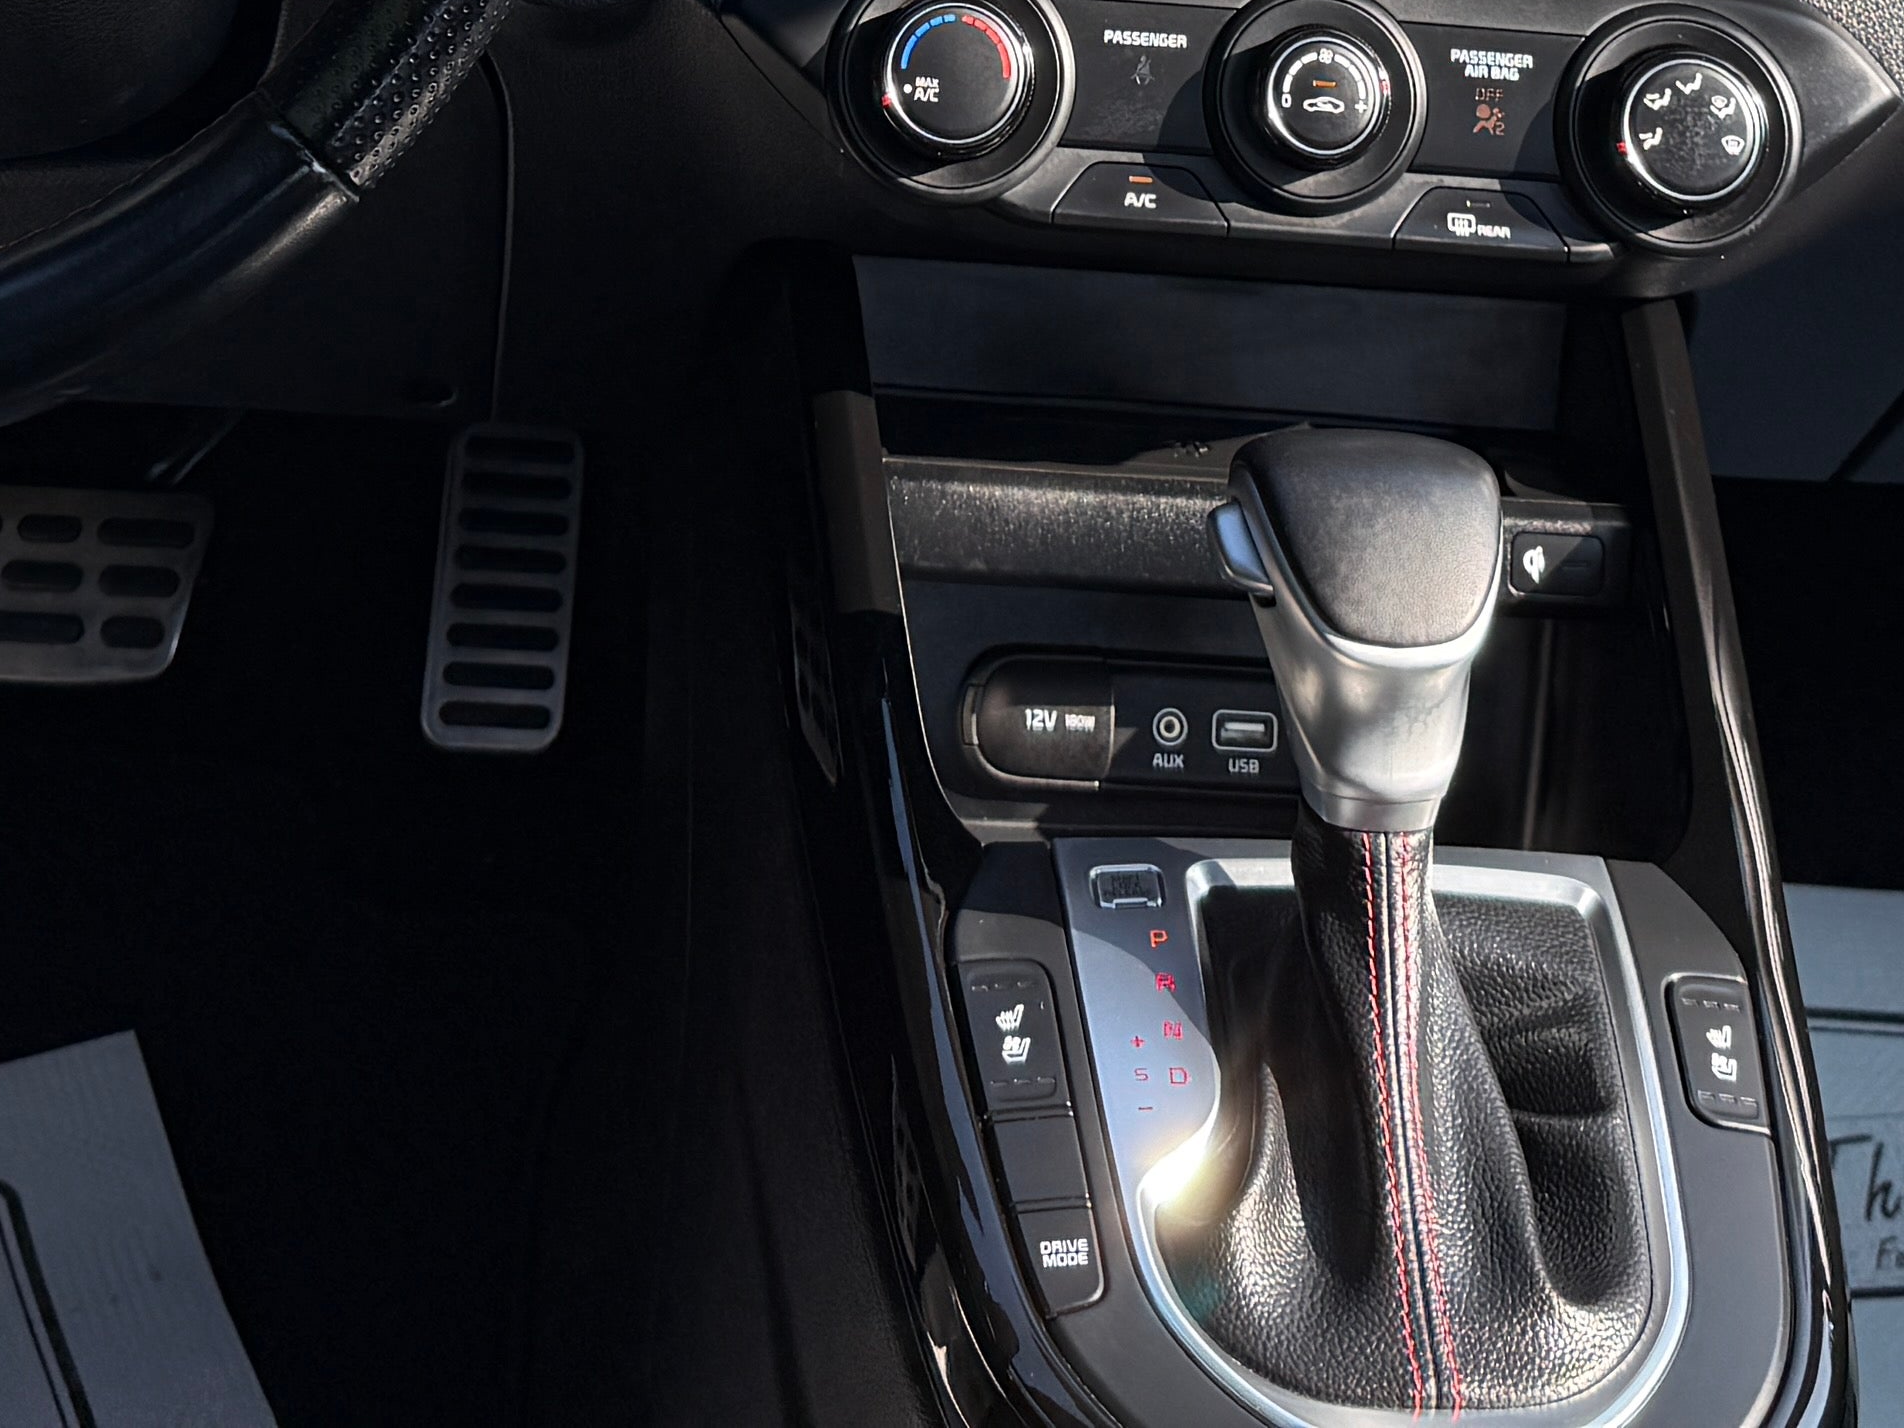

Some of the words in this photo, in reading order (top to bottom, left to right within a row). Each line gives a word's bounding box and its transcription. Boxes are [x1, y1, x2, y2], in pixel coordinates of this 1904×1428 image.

[1104, 29, 1187, 48] PASSENGER
[1450, 48, 1533, 69] PASSENGER
[1465, 64, 1488, 79] AIR
[1491, 66, 1520, 81] BAG
[915, 76, 939, 88] MAX
[914, 88, 939, 103] A/C
[1124, 192, 1157, 209] A/C
[1477, 224, 1511, 239] REAR
[1025, 708, 1057, 732] 12V
[1152, 753, 1185, 768] AUX
[1228, 758, 1260, 773] USB
[1150, 930, 1169, 948] P
[1156, 972, 1176, 992] R
[1169, 1067, 1190, 1086] D
[1040, 1238, 1089, 1254] DRIVE
[1042, 1251, 1089, 1266] MODE
